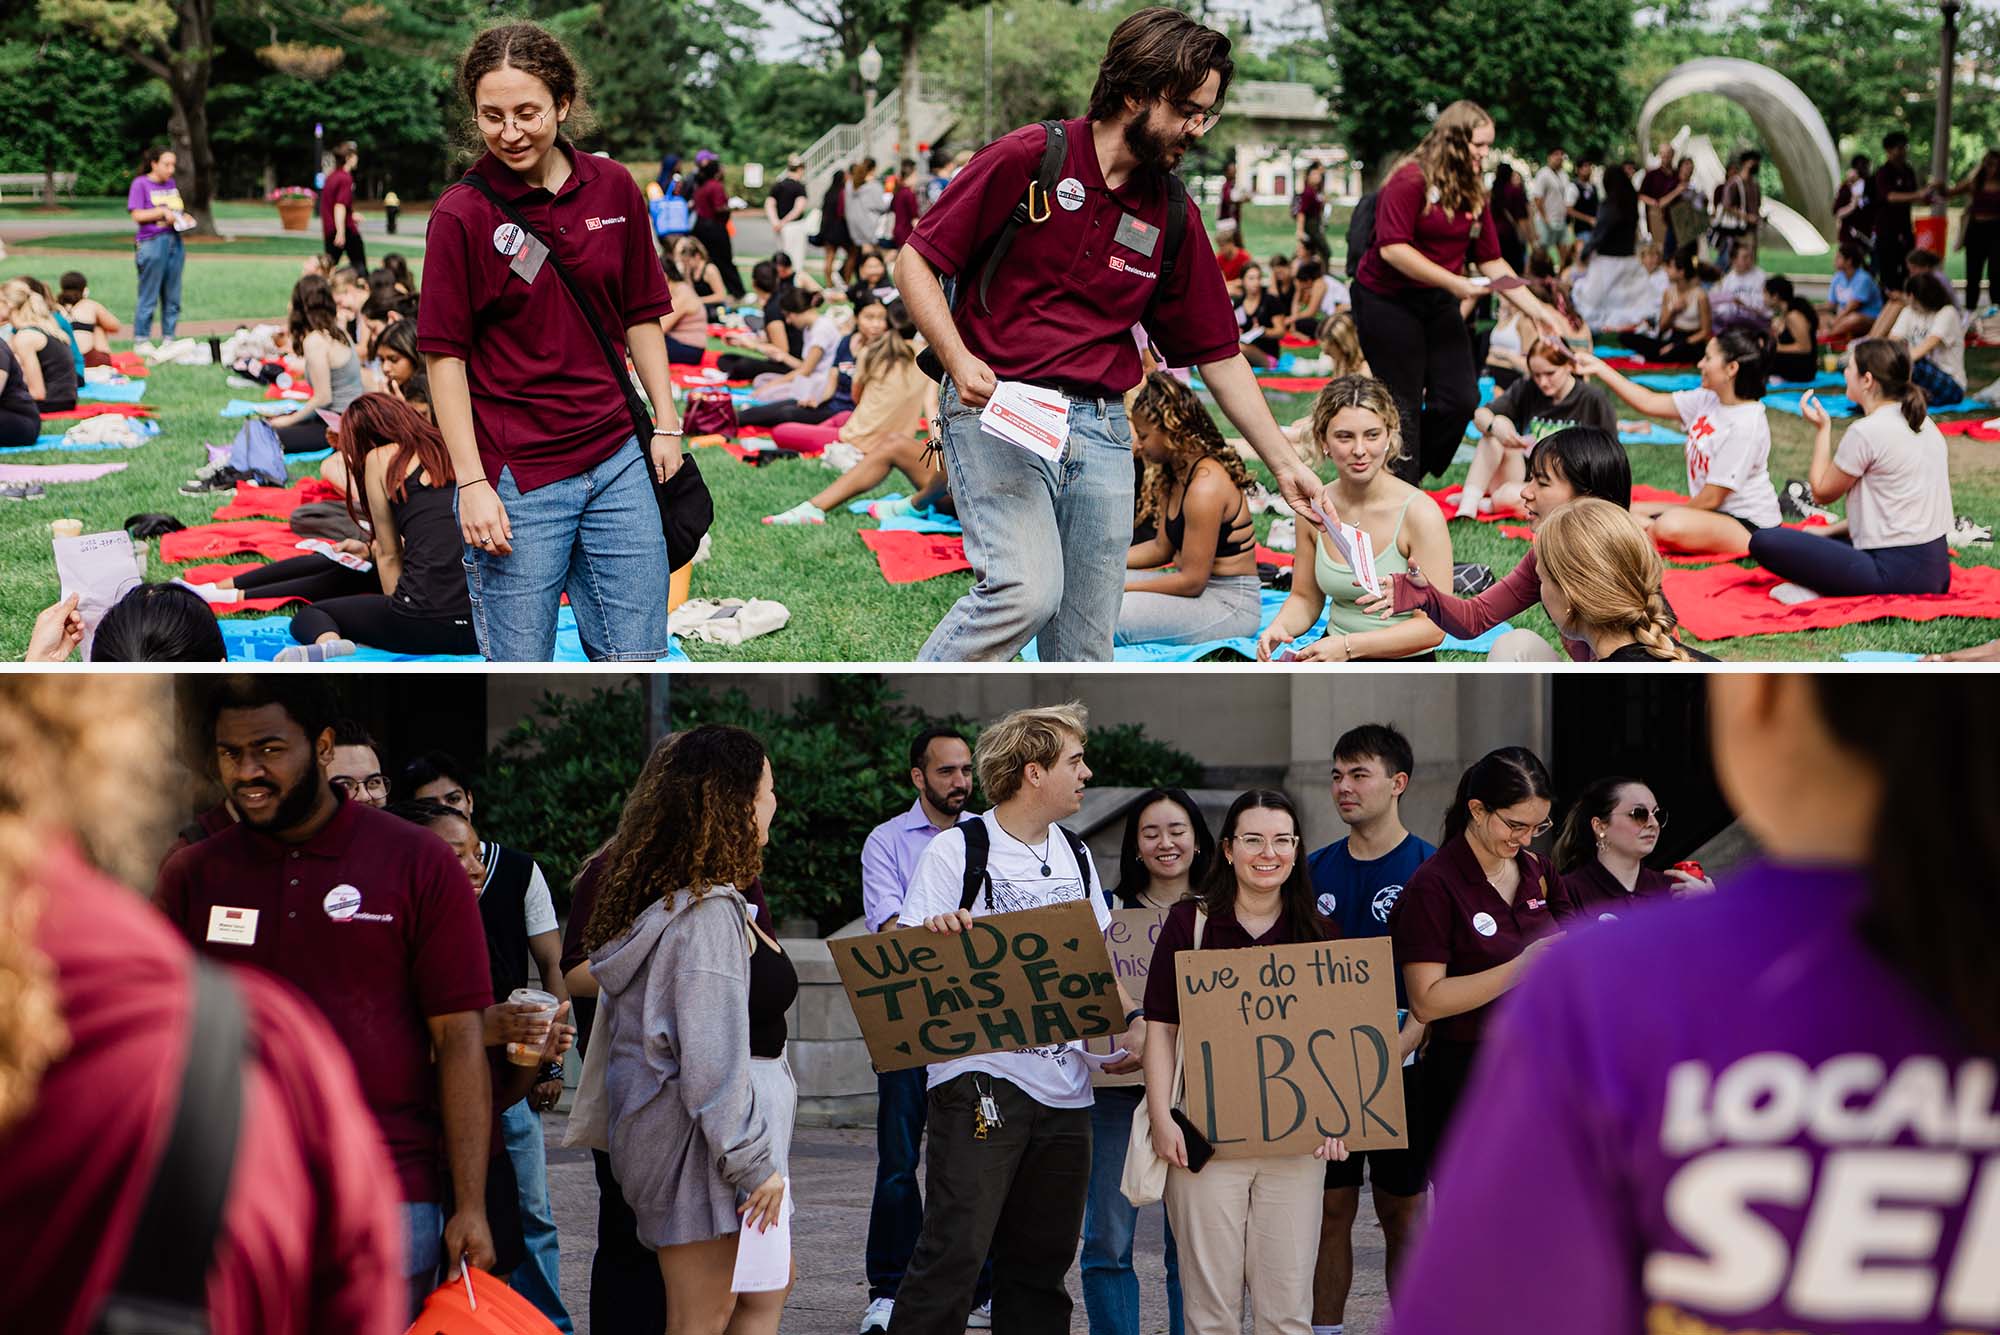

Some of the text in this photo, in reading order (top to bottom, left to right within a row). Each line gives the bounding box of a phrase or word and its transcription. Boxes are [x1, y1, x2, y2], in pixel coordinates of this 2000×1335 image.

[850, 922, 1049, 979] We Do
[1113, 951, 1148, 978] his
[1185, 948, 1370, 996] we do this
[1021, 958, 1116, 1001] For
[1237, 990, 1298, 1026] for
[1200, 1024, 1399, 1144] LBSR
[1660, 1051, 2000, 1156] LOCAL
